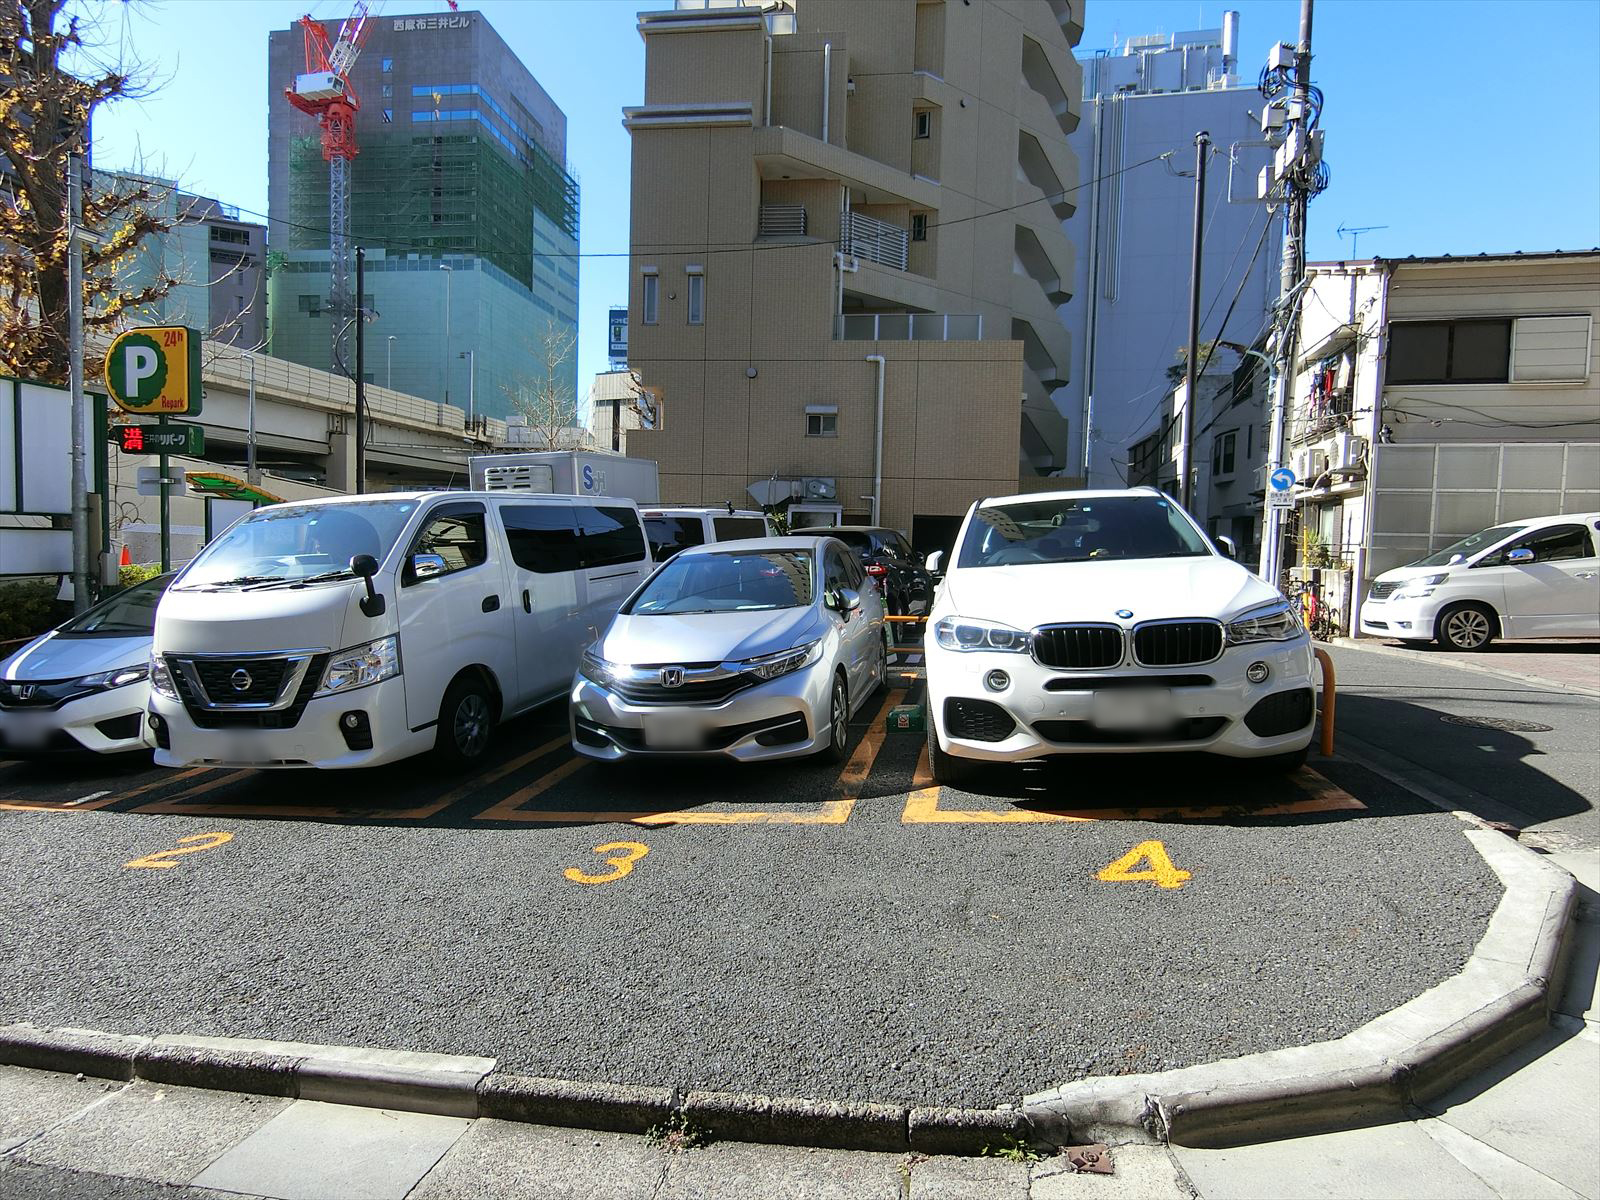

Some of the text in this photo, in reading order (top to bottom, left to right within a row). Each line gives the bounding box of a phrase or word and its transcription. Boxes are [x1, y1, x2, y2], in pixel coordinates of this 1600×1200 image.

[393, 17, 470, 32] 西麻布三井ビル
[125, 346, 158, 398] P
[161, 396, 185, 410] Repark
[123, 427, 144, 450] 満
[123, 832, 234, 869] 2
[563, 841, 650, 885] 3
[1098, 840, 1192, 889] 4
